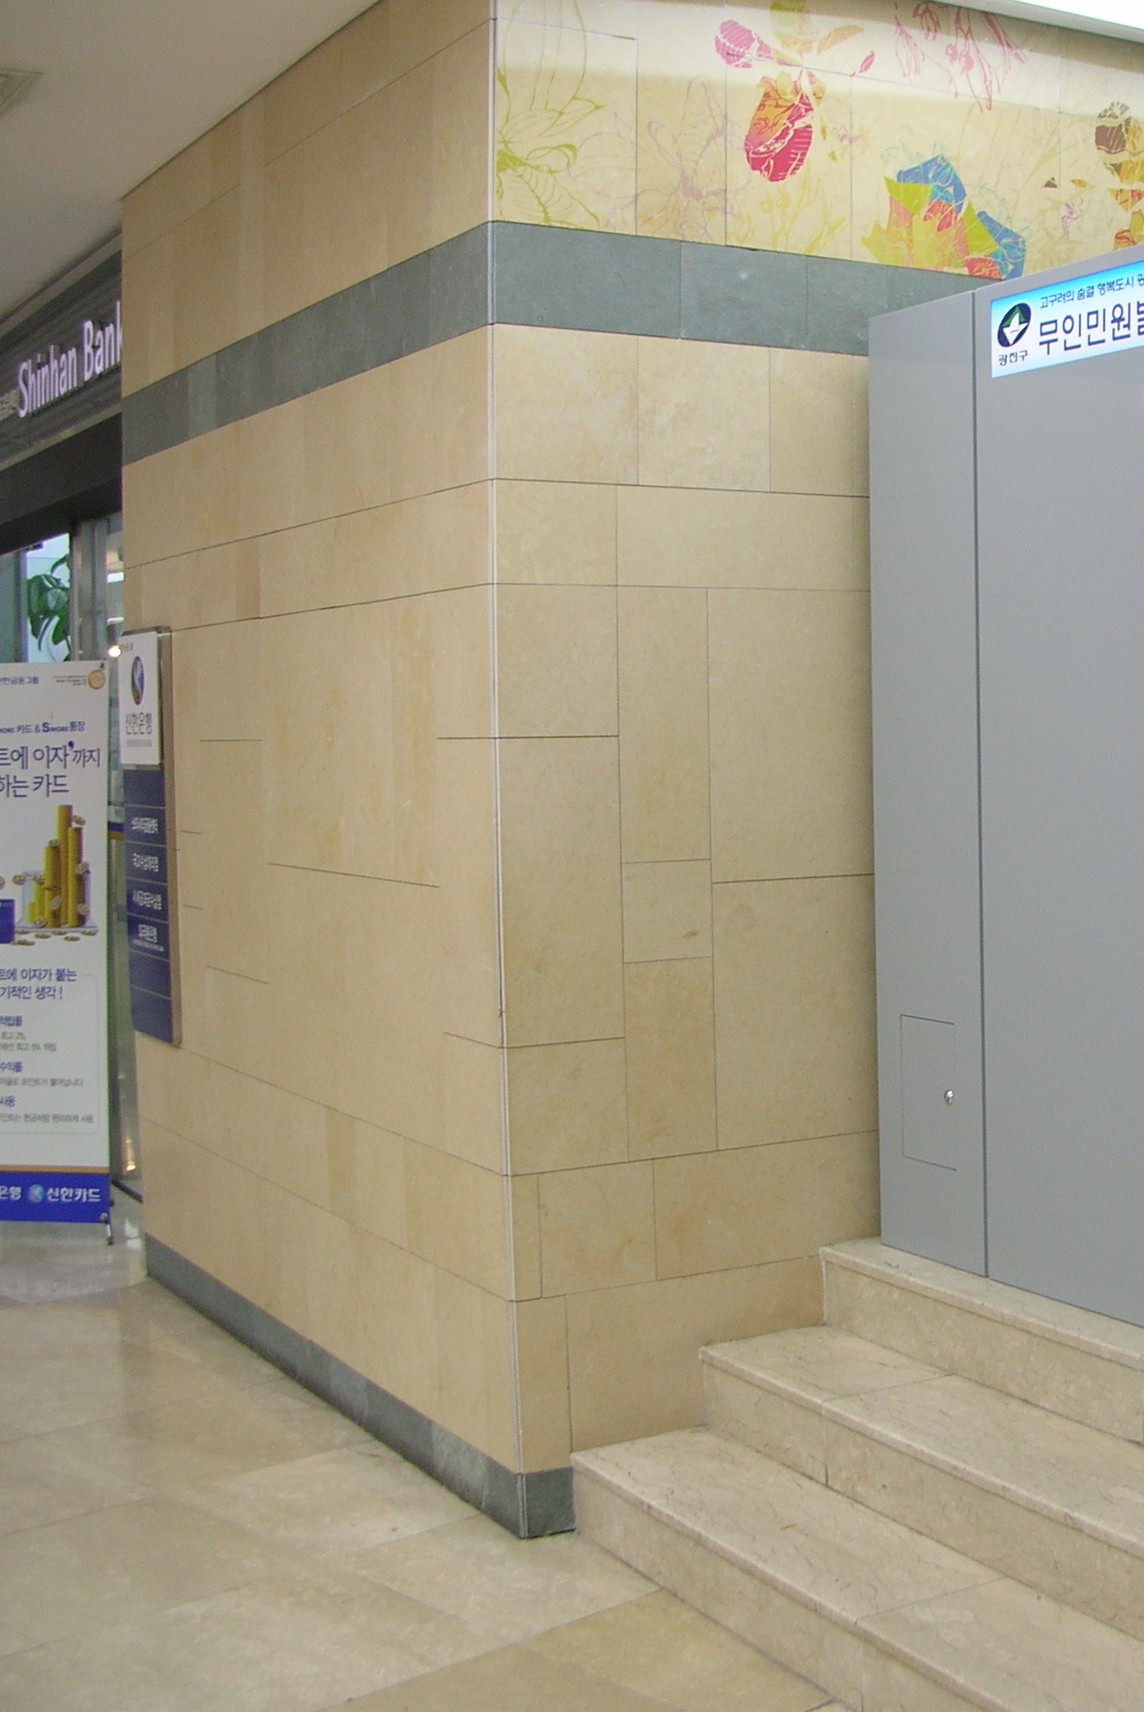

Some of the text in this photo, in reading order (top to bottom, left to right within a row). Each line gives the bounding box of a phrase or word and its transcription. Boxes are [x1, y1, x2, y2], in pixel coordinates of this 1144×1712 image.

[1040, 290, 1075, 309] 고구려의
[1097, 277, 1134, 296] 행복도시
[998, 350, 1029, 366] 광진구
[18, 345, 78, 418] Shinhan
[33, 773, 69, 797] 카드
[20, 968, 52, 981] 이자가
[56, 968, 77, 981] 붙는
[35, 986, 56, 999] 생각
[0, 1185, 101, 1202] 은행 신한카드
